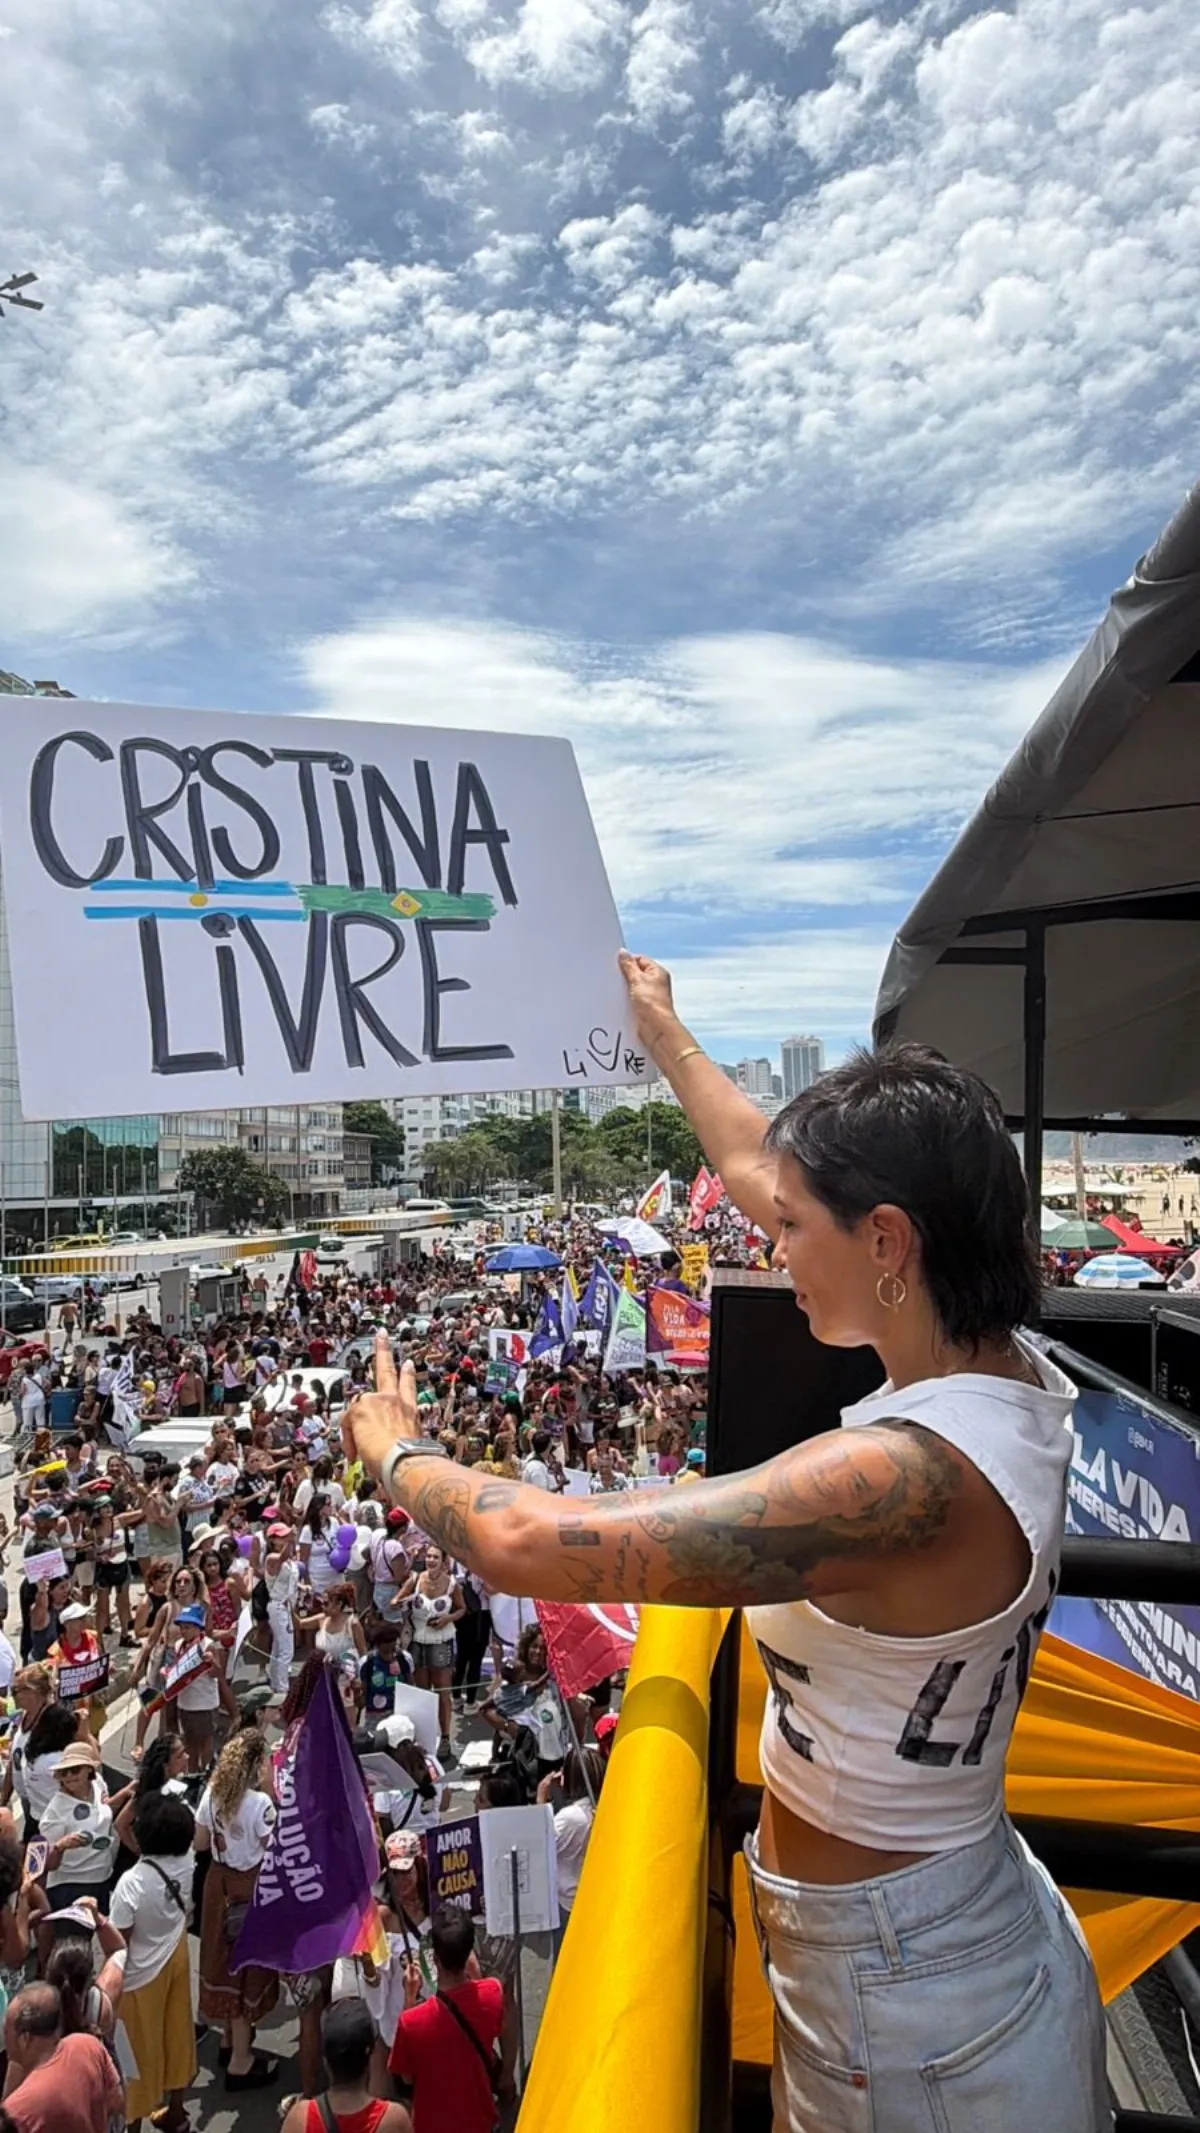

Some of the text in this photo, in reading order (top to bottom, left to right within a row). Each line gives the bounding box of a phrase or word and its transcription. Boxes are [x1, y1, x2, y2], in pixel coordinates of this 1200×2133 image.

[1066, 1475, 1138, 1539] HERES
[1111, 1459, 1191, 1542] VIDA
[436, 1827, 473, 1854] AMOR
[441, 1849, 469, 1873] NÃO
[437, 1869, 477, 1897] CAUSA
